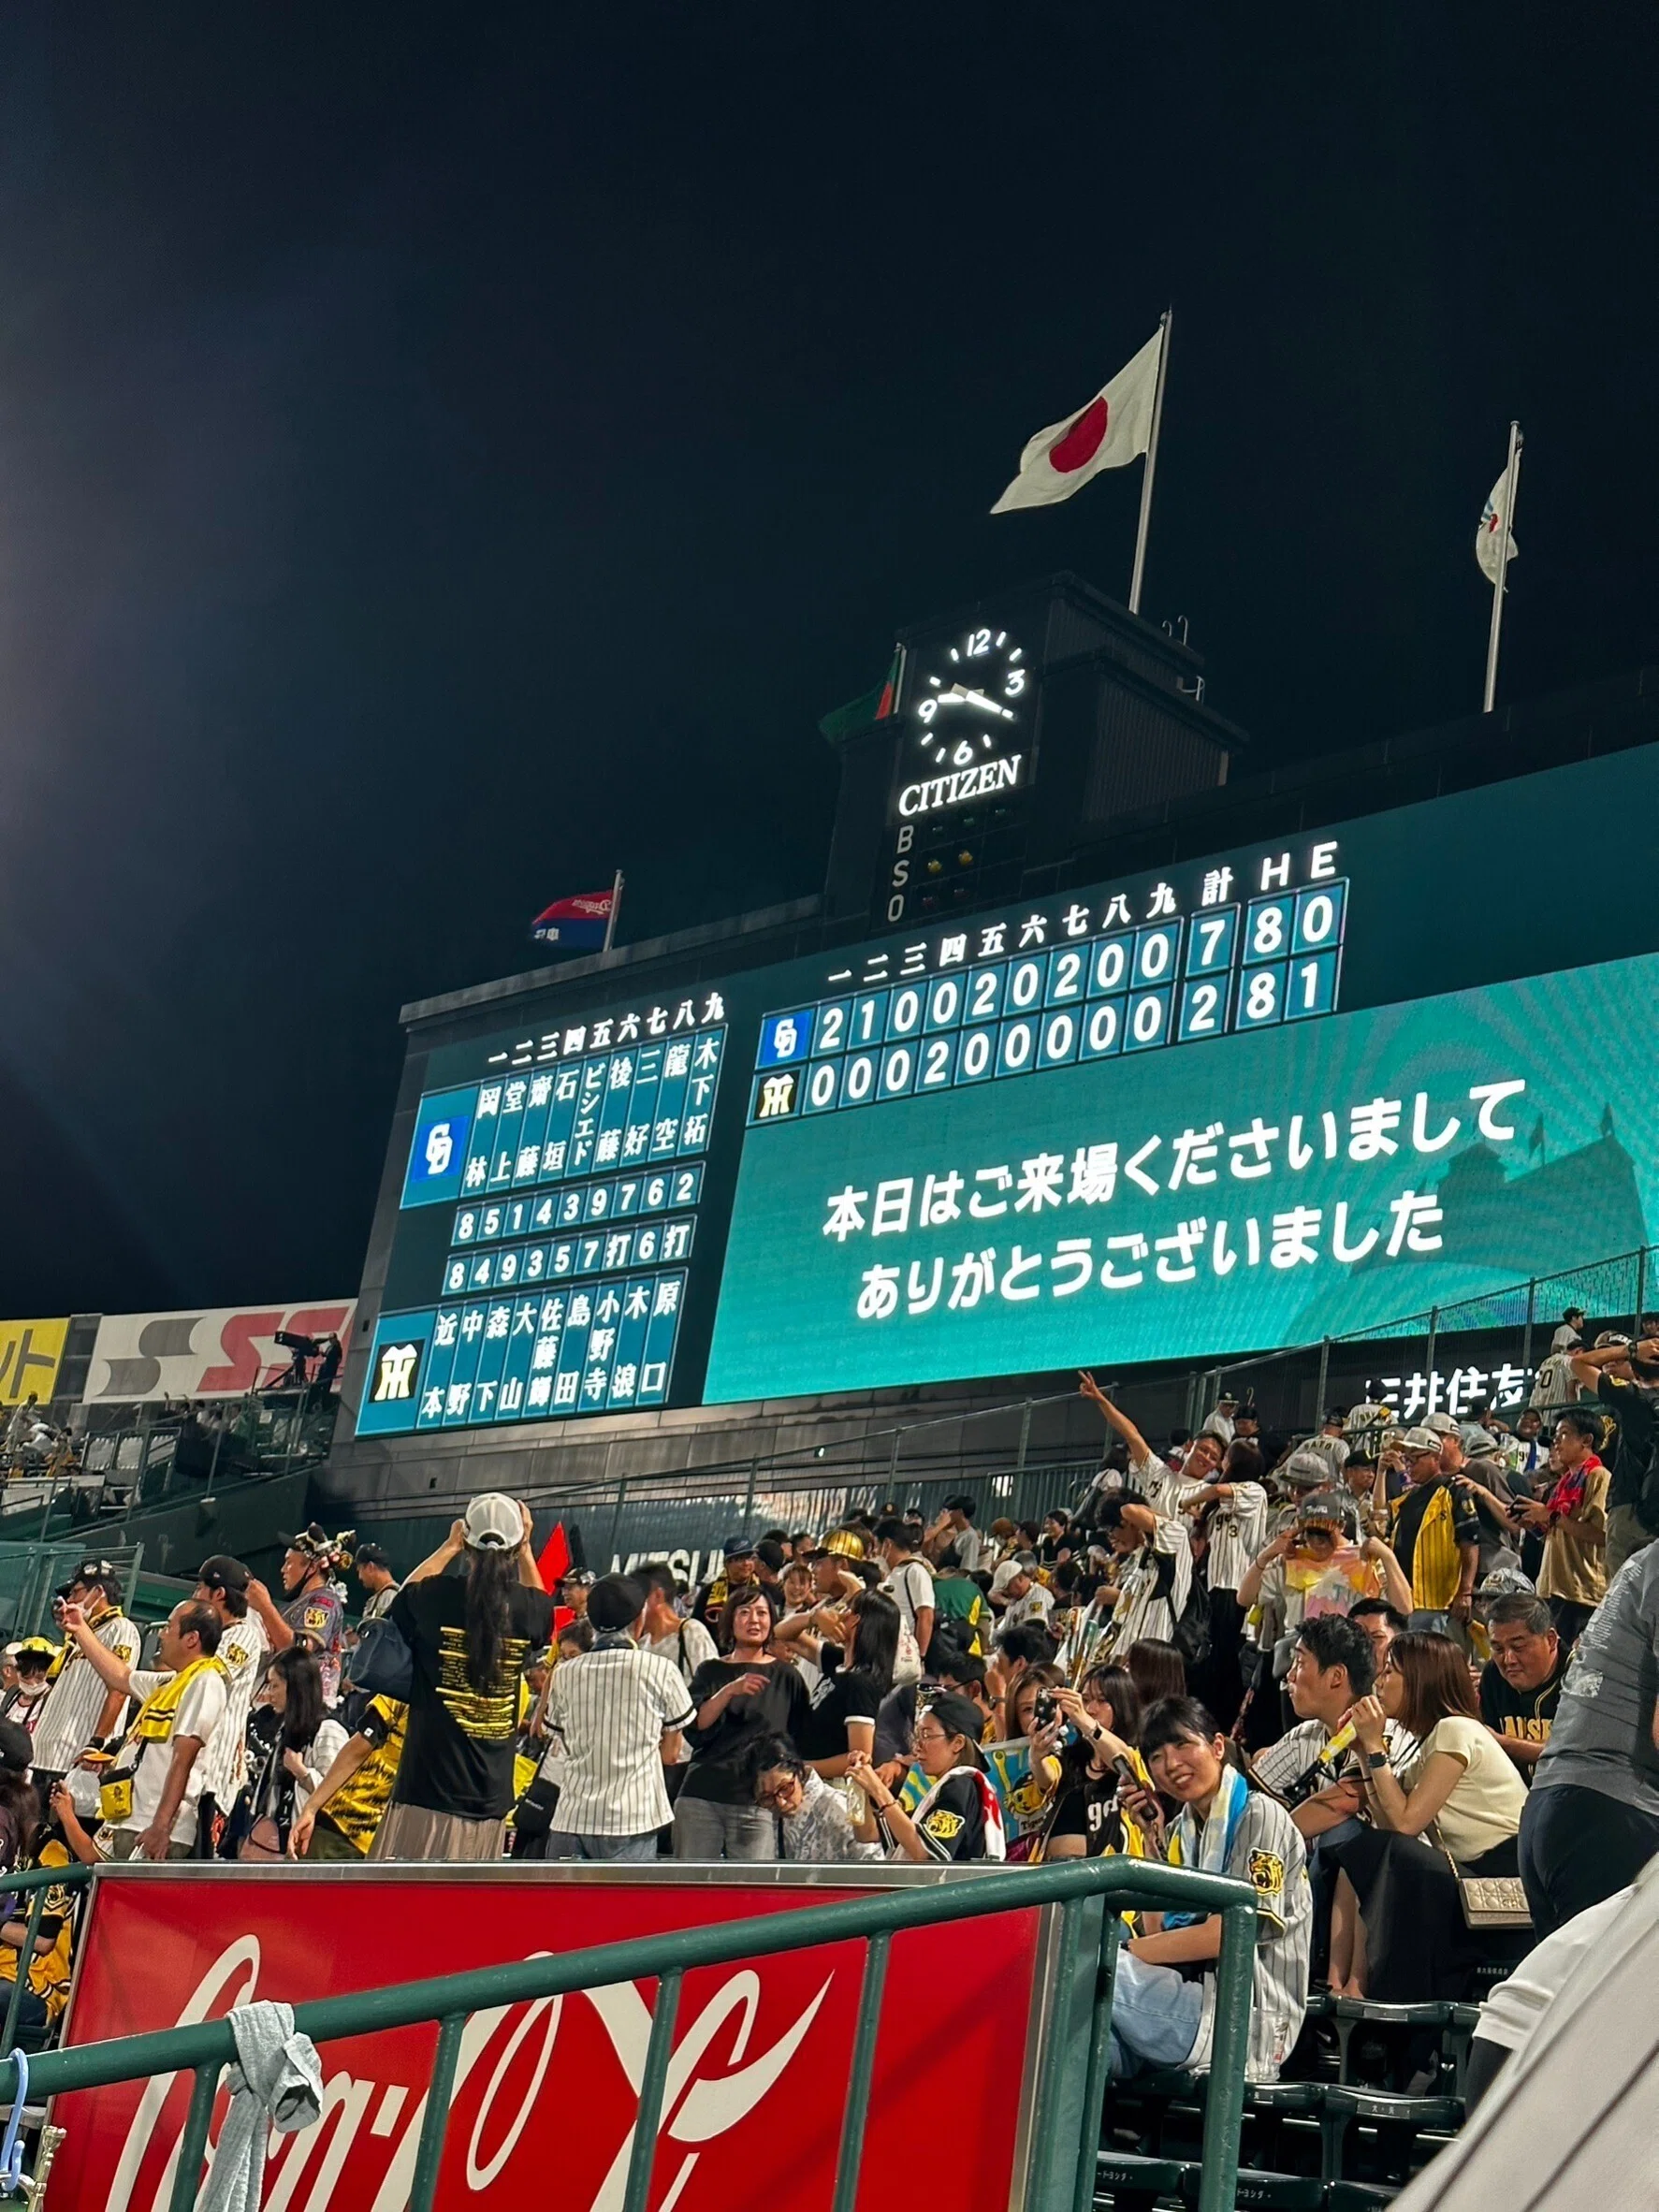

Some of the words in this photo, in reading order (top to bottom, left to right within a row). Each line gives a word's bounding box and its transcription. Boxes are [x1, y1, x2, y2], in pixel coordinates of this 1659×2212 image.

[968, 629, 991, 657] 12
[1005, 669, 1026, 696] 3
[918, 700, 938, 723] 9
[953, 740, 973, 766] 6
[898, 754, 1022, 817] CITIZEN
[893, 859, 910, 887] S
[896, 825, 914, 853] B
[828, 969, 851, 982] 一
[863, 953, 889, 982] 二
[900, 942, 927, 975] 三
[939, 933, 968, 967] 四
[978, 923, 1007, 957] 五
[1018, 914, 1047, 948] 六
[1062, 904, 1089, 937] 七
[1102, 894, 1131, 929] 八
[1145, 882, 1176, 919] 九
[1201, 866, 1234, 907] 計
[1260, 852, 1290, 891] H
[1310, 840, 1338, 880] E
[888, 895, 904, 922] O
[819, 1008, 843, 1049] 2
[862, 1000, 875, 1040] 1
[894, 990, 919, 1032] 0
[933, 982, 957, 1024] 0
[971, 972, 997, 1016] 2
[1012, 963, 1039, 1006] 0
[1054, 953, 1081, 997] 2
[1097, 943, 1125, 988] 0
[1141, 933, 1169, 978] 0
[1200, 919, 1226, 966] 7
[1253, 907, 1283, 953] 8
[1302, 895, 1333, 942] 0
[488, 1052, 508, 1063] 一
[511, 1040, 533, 1065] 二
[536, 1031, 560, 1061] 三
[562, 1026, 587, 1055] 四
[589, 1018, 614, 1049] 五
[617, 1012, 641, 1042] 六
[646, 1007, 668, 1035] 七
[673, 999, 695, 1030] 八
[701, 992, 724, 1024] 九
[811, 1065, 835, 1106] 0
[848, 1057, 872, 1099] 0
[886, 1049, 910, 1091] 0
[924, 1041, 949, 1084] 2
[964, 1032, 989, 1076] 0
[1005, 1024, 1031, 1068] 0
[1046, 1014, 1073, 1059] 0
[1089, 1005, 1116, 1051] 0
[1133, 996, 1161, 1041] 0
[1188, 984, 1217, 1031] 2
[1246, 972, 1275, 1019] 8
[1301, 962, 1317, 1008] 1
[465, 1085, 502, 1188] 岡林
[489, 1081, 527, 1183] 堂上
[542, 1069, 580, 1171] 石垣
[574, 1062, 606, 1166] ビシエド
[595, 1056, 633, 1162] 後藤
[623, 1049, 661, 1157] 三好
[651, 1043, 691, 1152] 龍空
[683, 1037, 720, 1145] 木下拓
[458, 1213, 474, 1240] 8
[484, 1208, 501, 1235] 5
[513, 1203, 523, 1230] 1
[536, 1199, 552, 1225] 4
[563, 1193, 579, 1221] 3
[590, 1188, 607, 1216] 9
[621, 1183, 636, 1211] 7
[648, 1178, 664, 1206] 6
[677, 1172, 694, 1201] 2
[822, 1078, 1526, 1243] 本日はご来場くださいまして
[449, 1262, 465, 1289] 8
[474, 1259, 490, 1285] 4
[501, 1254, 517, 1282] 9
[527, 1249, 544, 1277] 3
[554, 1244, 571, 1273] 5
[584, 1240, 599, 1268] 7
[605, 1234, 632, 1268] 打
[639, 1230, 656, 1259] 6
[663, 1224, 691, 1259] 打
[855, 1189, 1444, 1320] ありがとうございました
[421, 1313, 458, 1419] 近本
[445, 1310, 484, 1416] 中野
[476, 1305, 511, 1412] 森下
[499, 1302, 538, 1411] 大山
[554, 1294, 591, 1404] 島田
[584, 1289, 620, 1401] 小野寺
[611, 1286, 650, 1399] 木浪
[641, 1280, 681, 1393] 原口
[1365, 1362, 1539, 1420] 三井住友
